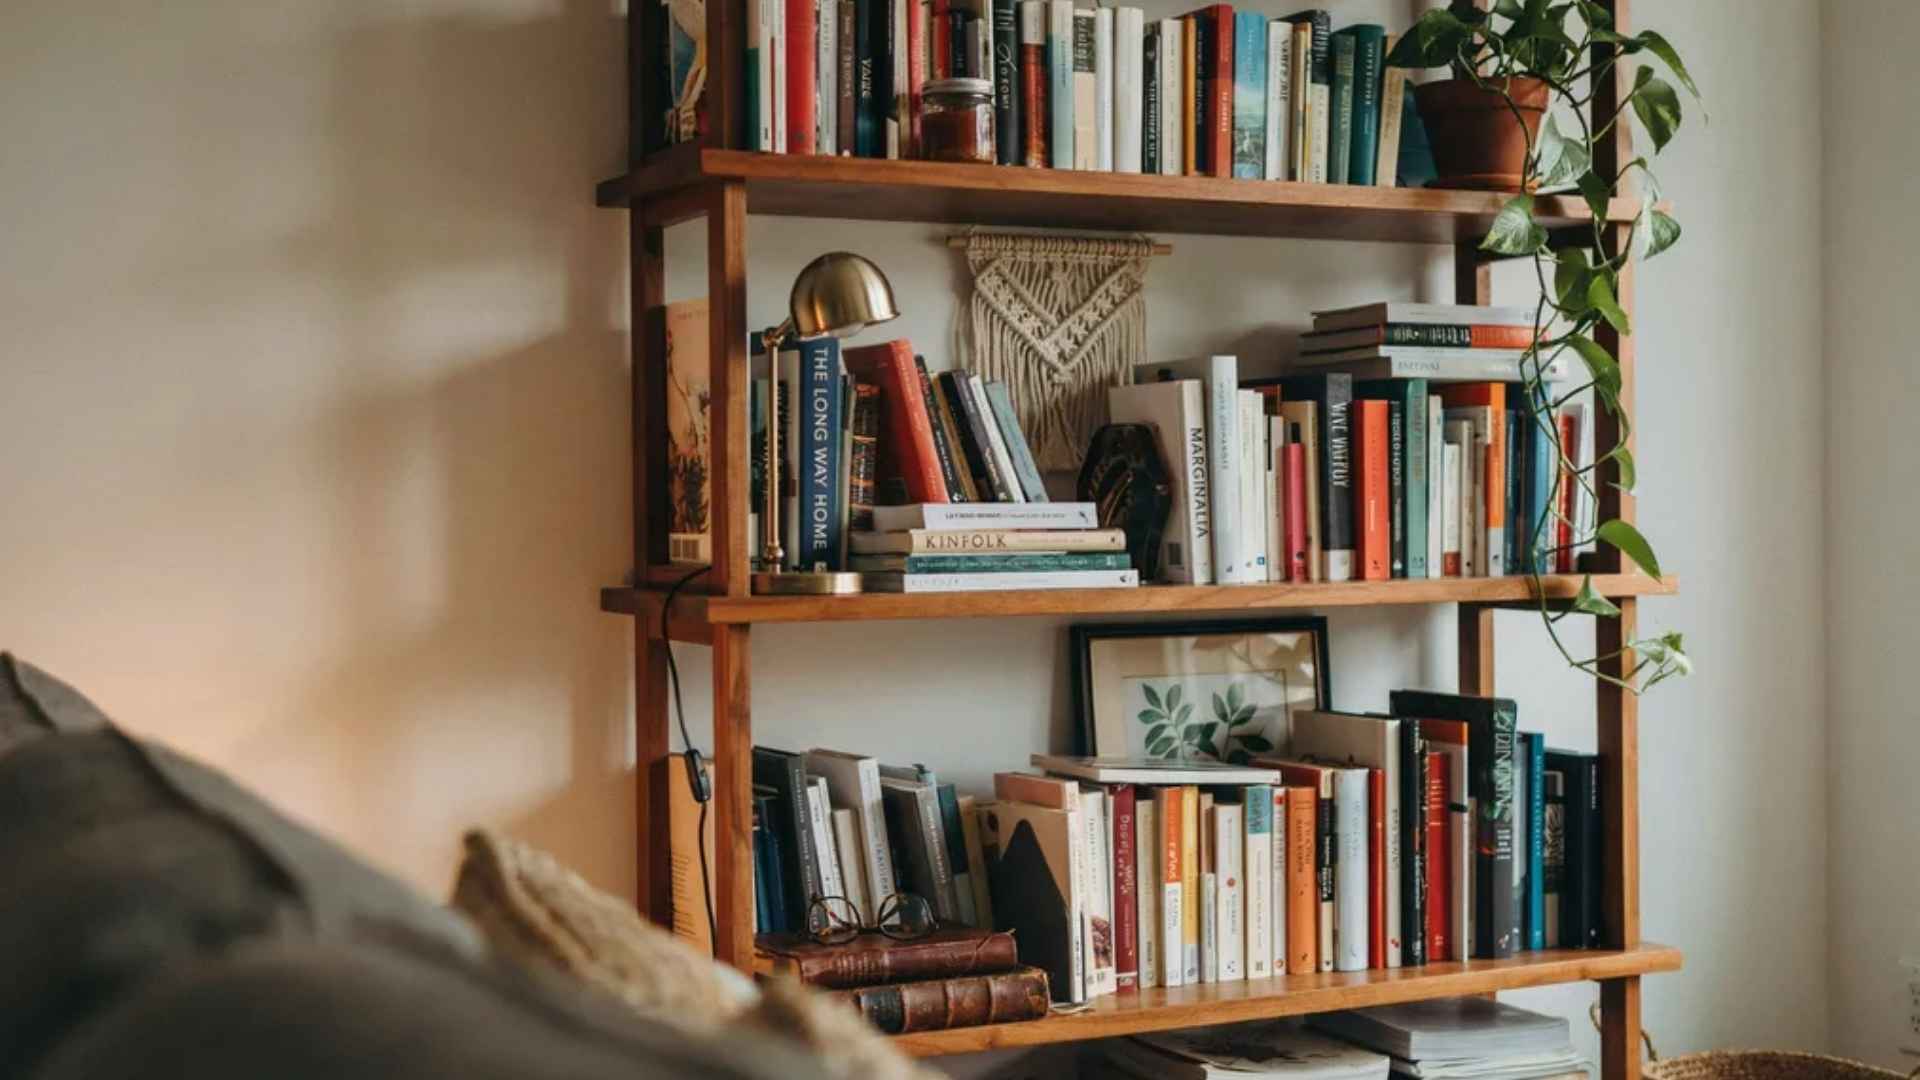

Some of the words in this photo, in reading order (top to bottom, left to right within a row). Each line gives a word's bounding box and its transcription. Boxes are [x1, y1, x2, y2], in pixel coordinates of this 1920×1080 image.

[812, 346, 829, 380] THE
[812, 387, 829, 442] LONG
[812, 446, 829, 488] WAY
[1189, 427, 1209, 538] MARGINALIA
[812, 494, 829, 550] HOME
[925, 533, 1008, 549] KINFOLK
